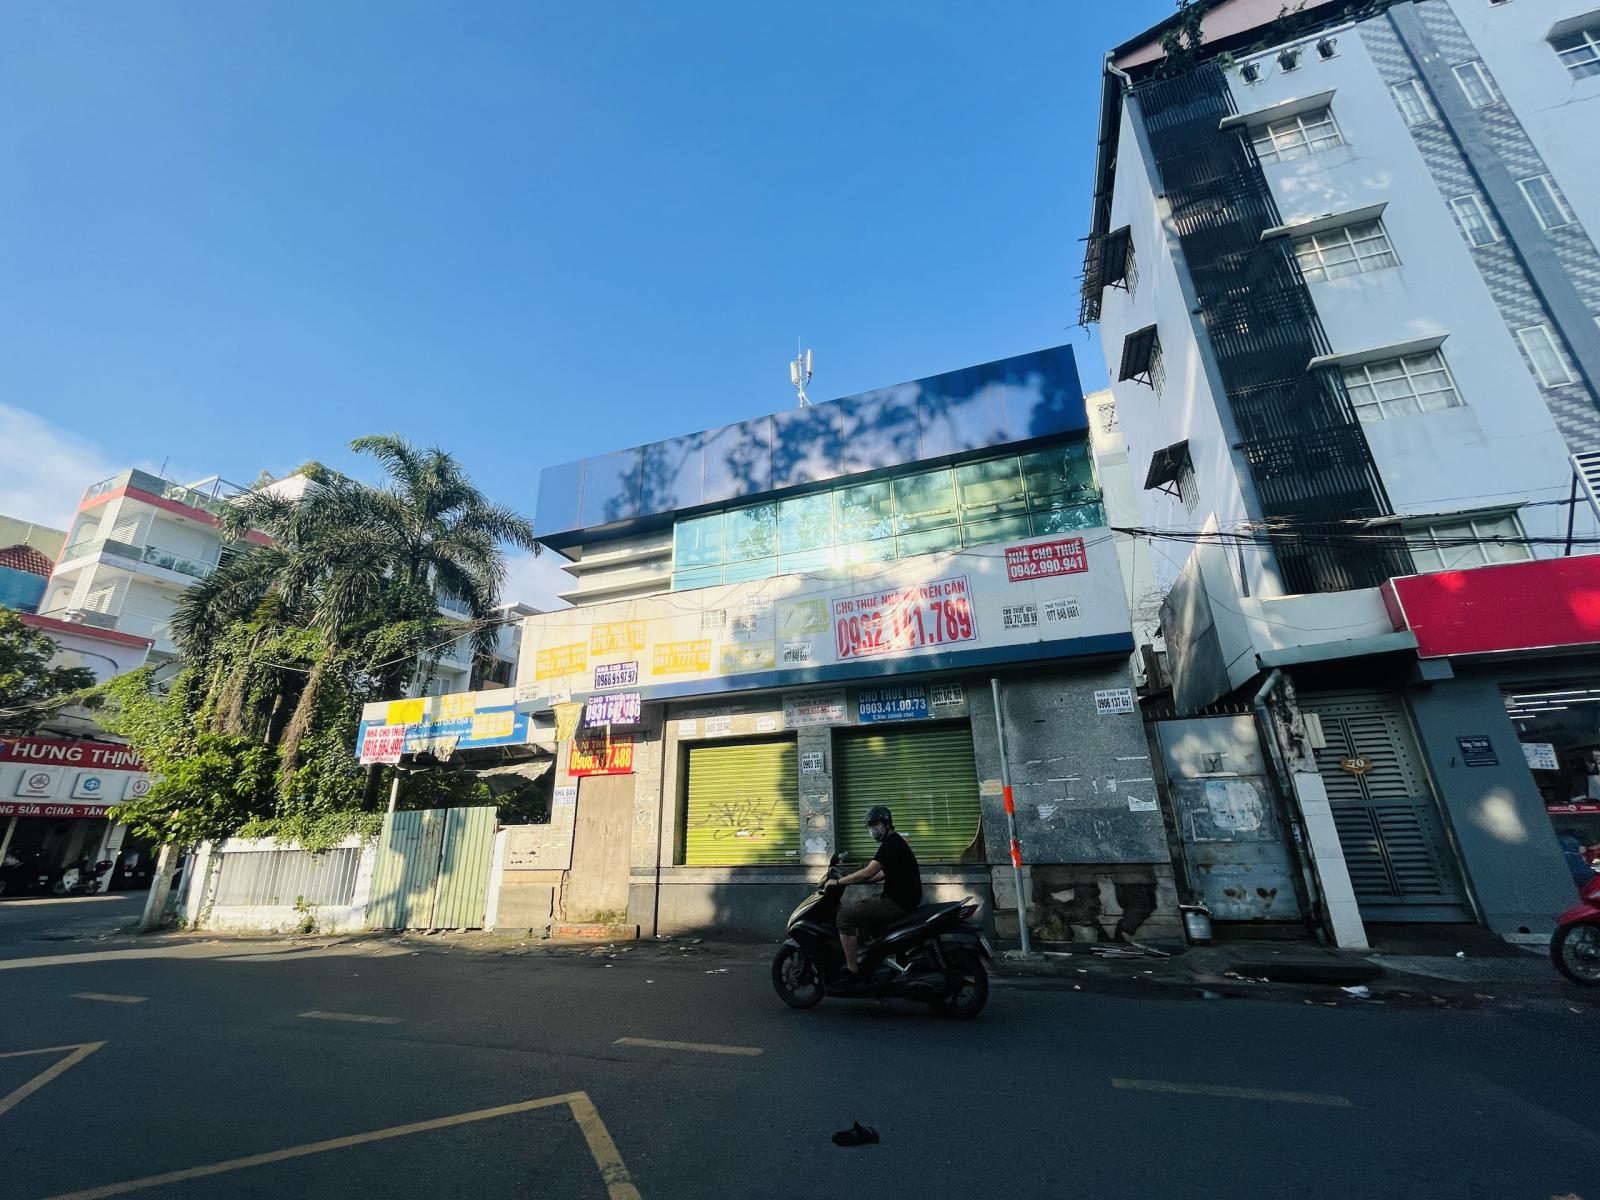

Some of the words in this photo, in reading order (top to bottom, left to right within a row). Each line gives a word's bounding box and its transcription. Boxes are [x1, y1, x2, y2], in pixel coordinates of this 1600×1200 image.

[1008, 547, 1030, 564] NHÀ
[1032, 546, 1053, 560] CHO
[1056, 541, 1082, 557] THUÊ
[1010, 557, 1083, 578] 0942.990.941
[836, 601, 853, 614] CHO
[860, 692, 878, 703] CHO
[860, 698, 926, 715] 0903.41.00.73
[11, 743, 83, 761] HƯNG
[1348, 758, 1365, 768] 70
